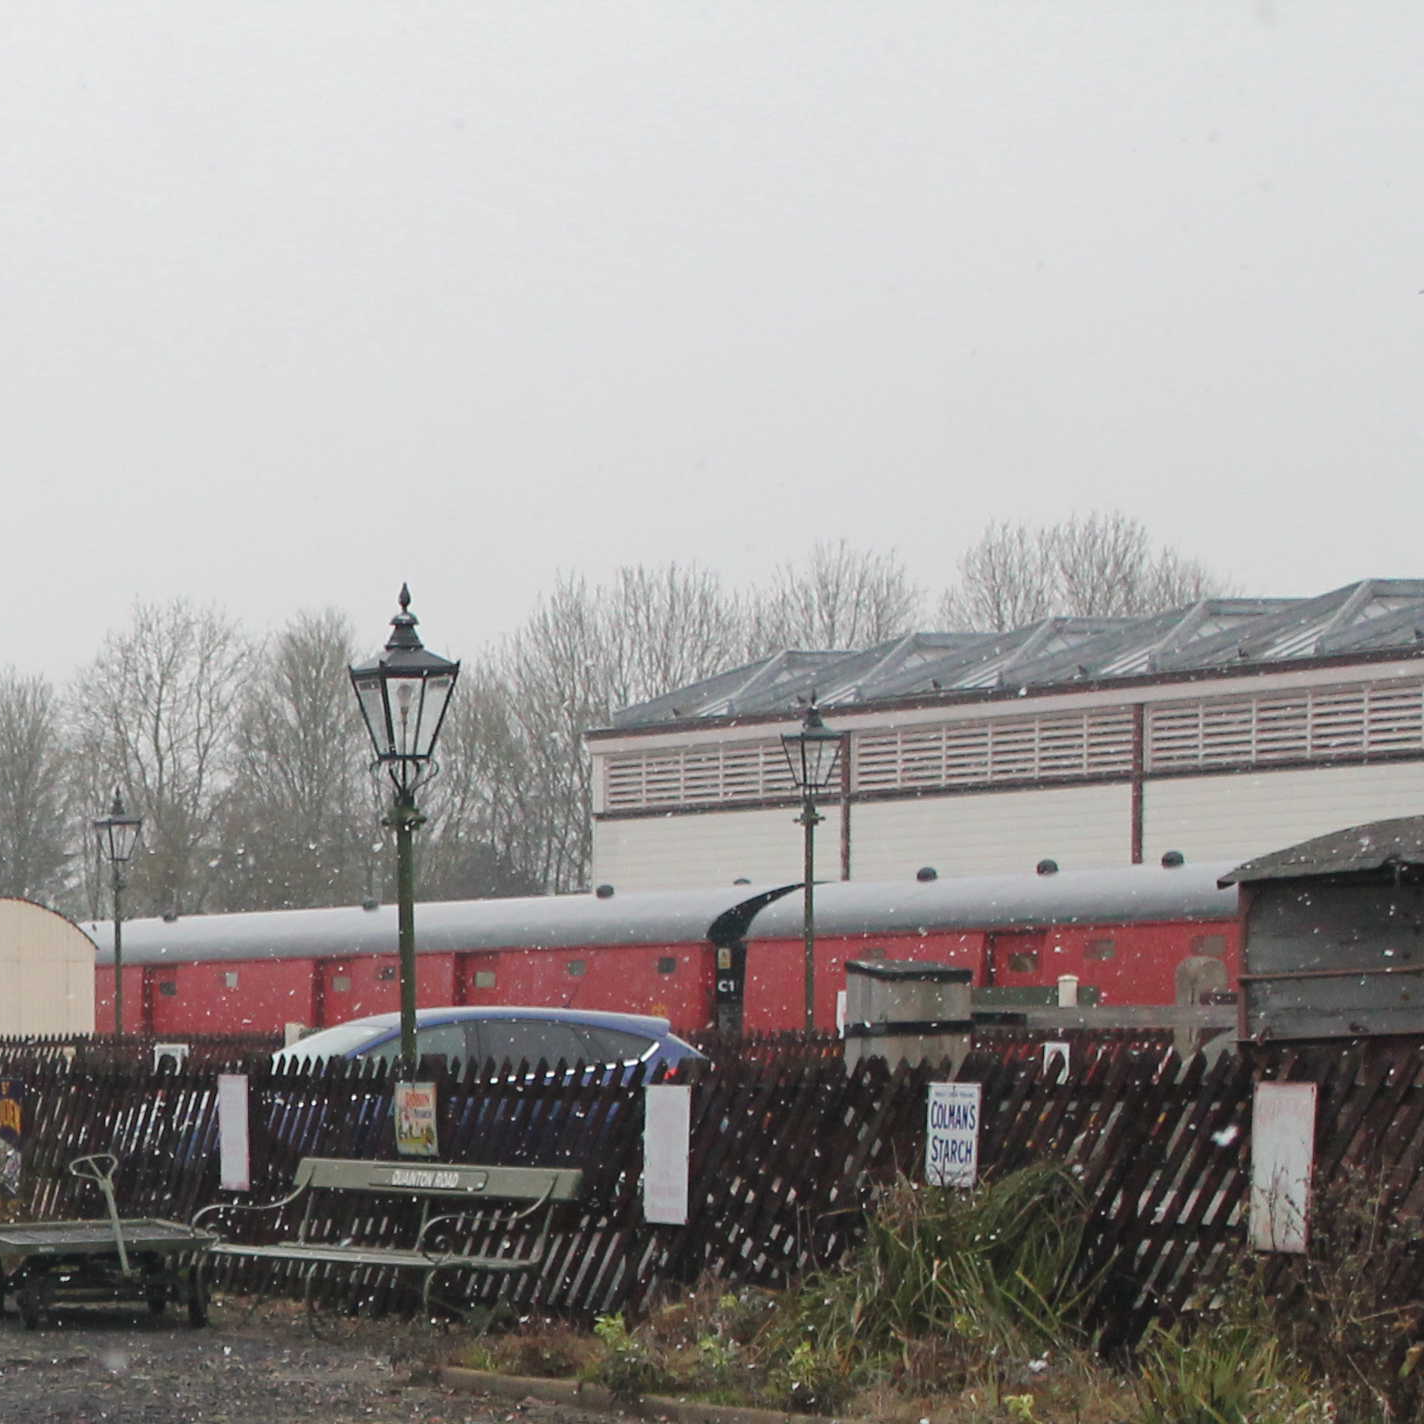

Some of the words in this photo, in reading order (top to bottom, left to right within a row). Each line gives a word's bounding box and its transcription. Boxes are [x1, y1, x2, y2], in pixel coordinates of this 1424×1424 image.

[717, 979, 736, 993] C1
[930, 1135, 973, 1165] STARCH
[433, 1170, 460, 1189] ROAD
